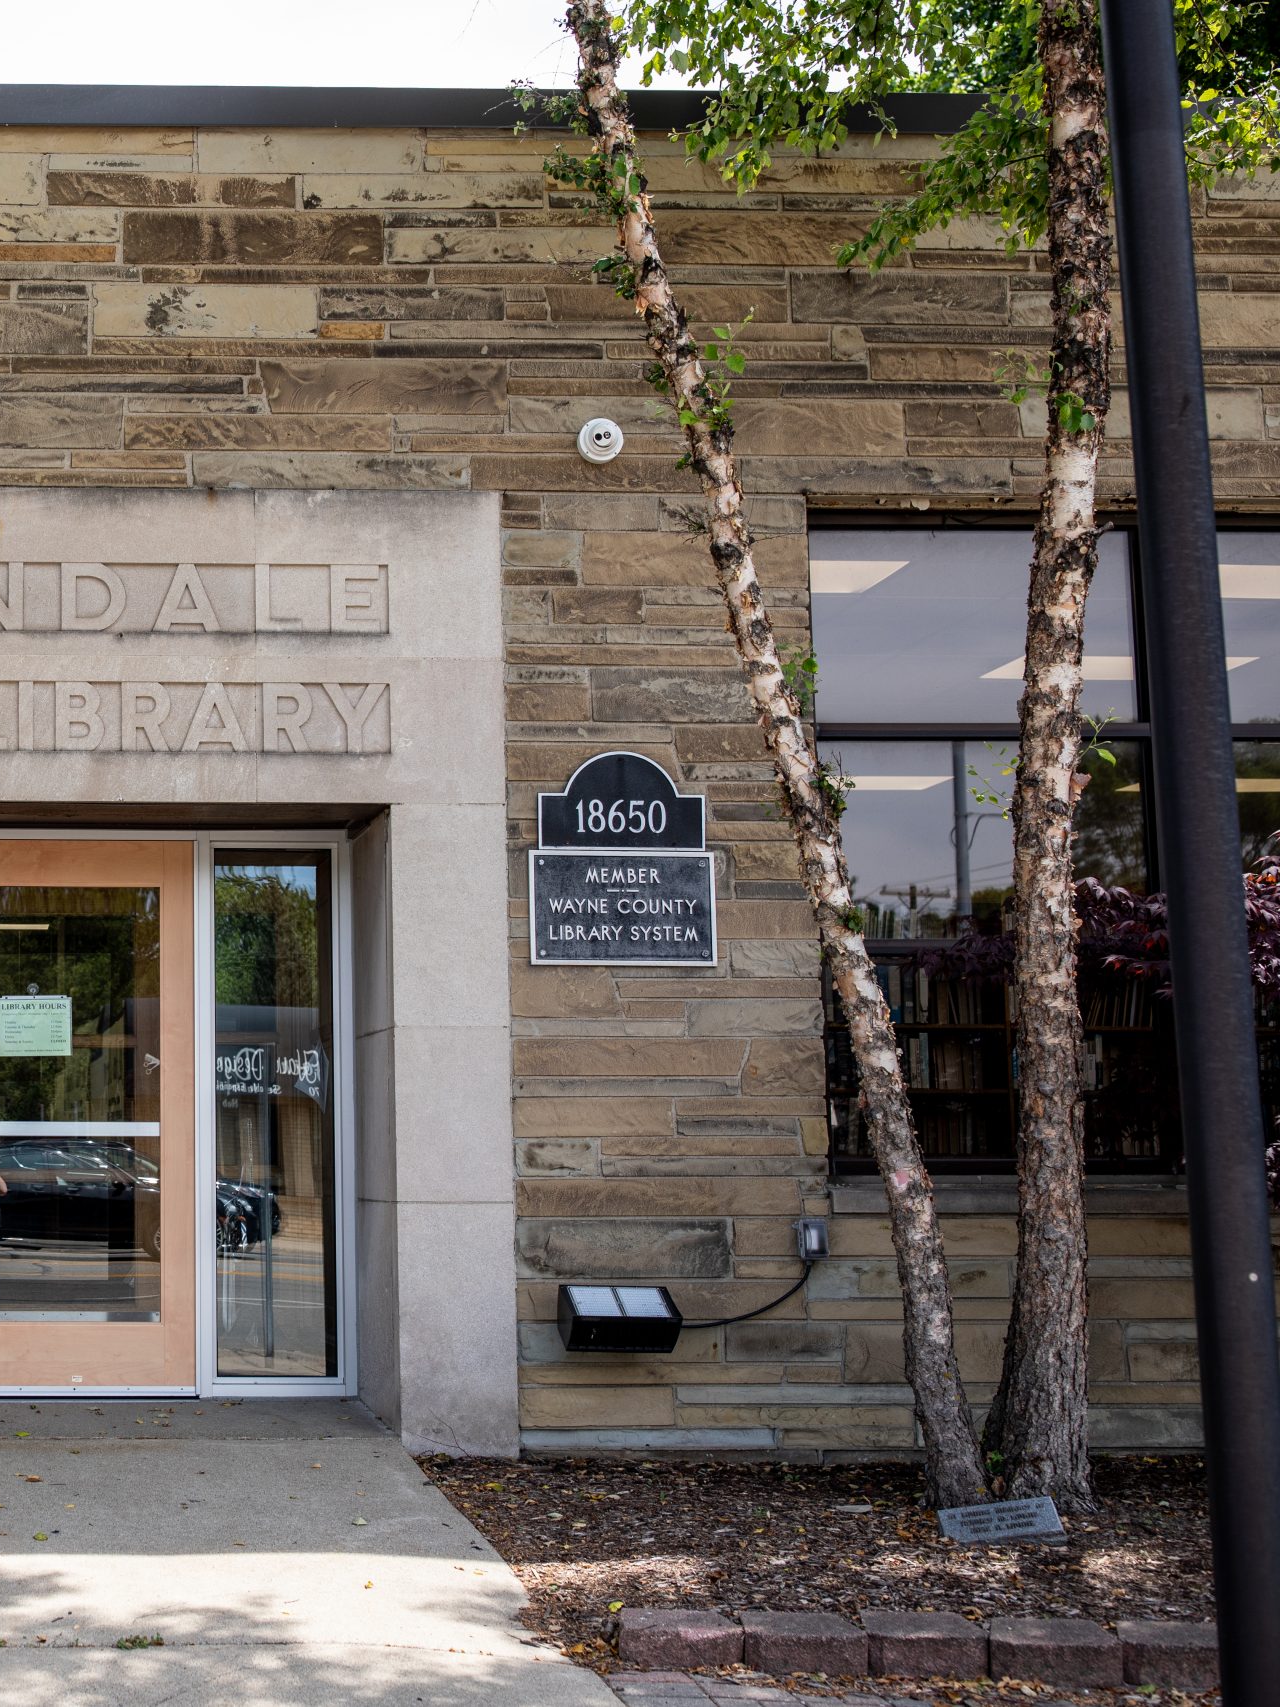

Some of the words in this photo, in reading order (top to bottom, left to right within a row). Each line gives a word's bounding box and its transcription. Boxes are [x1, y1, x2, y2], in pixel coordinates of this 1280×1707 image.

[575, 798, 667, 834] 18650
[585, 867, 660, 884] MEMBER
[549, 898, 608, 914] WAYNE
[617, 898, 697, 915] COUNTY
[549, 925, 623, 941] LIBRARY
[631, 925, 699, 942] SYSTEM
